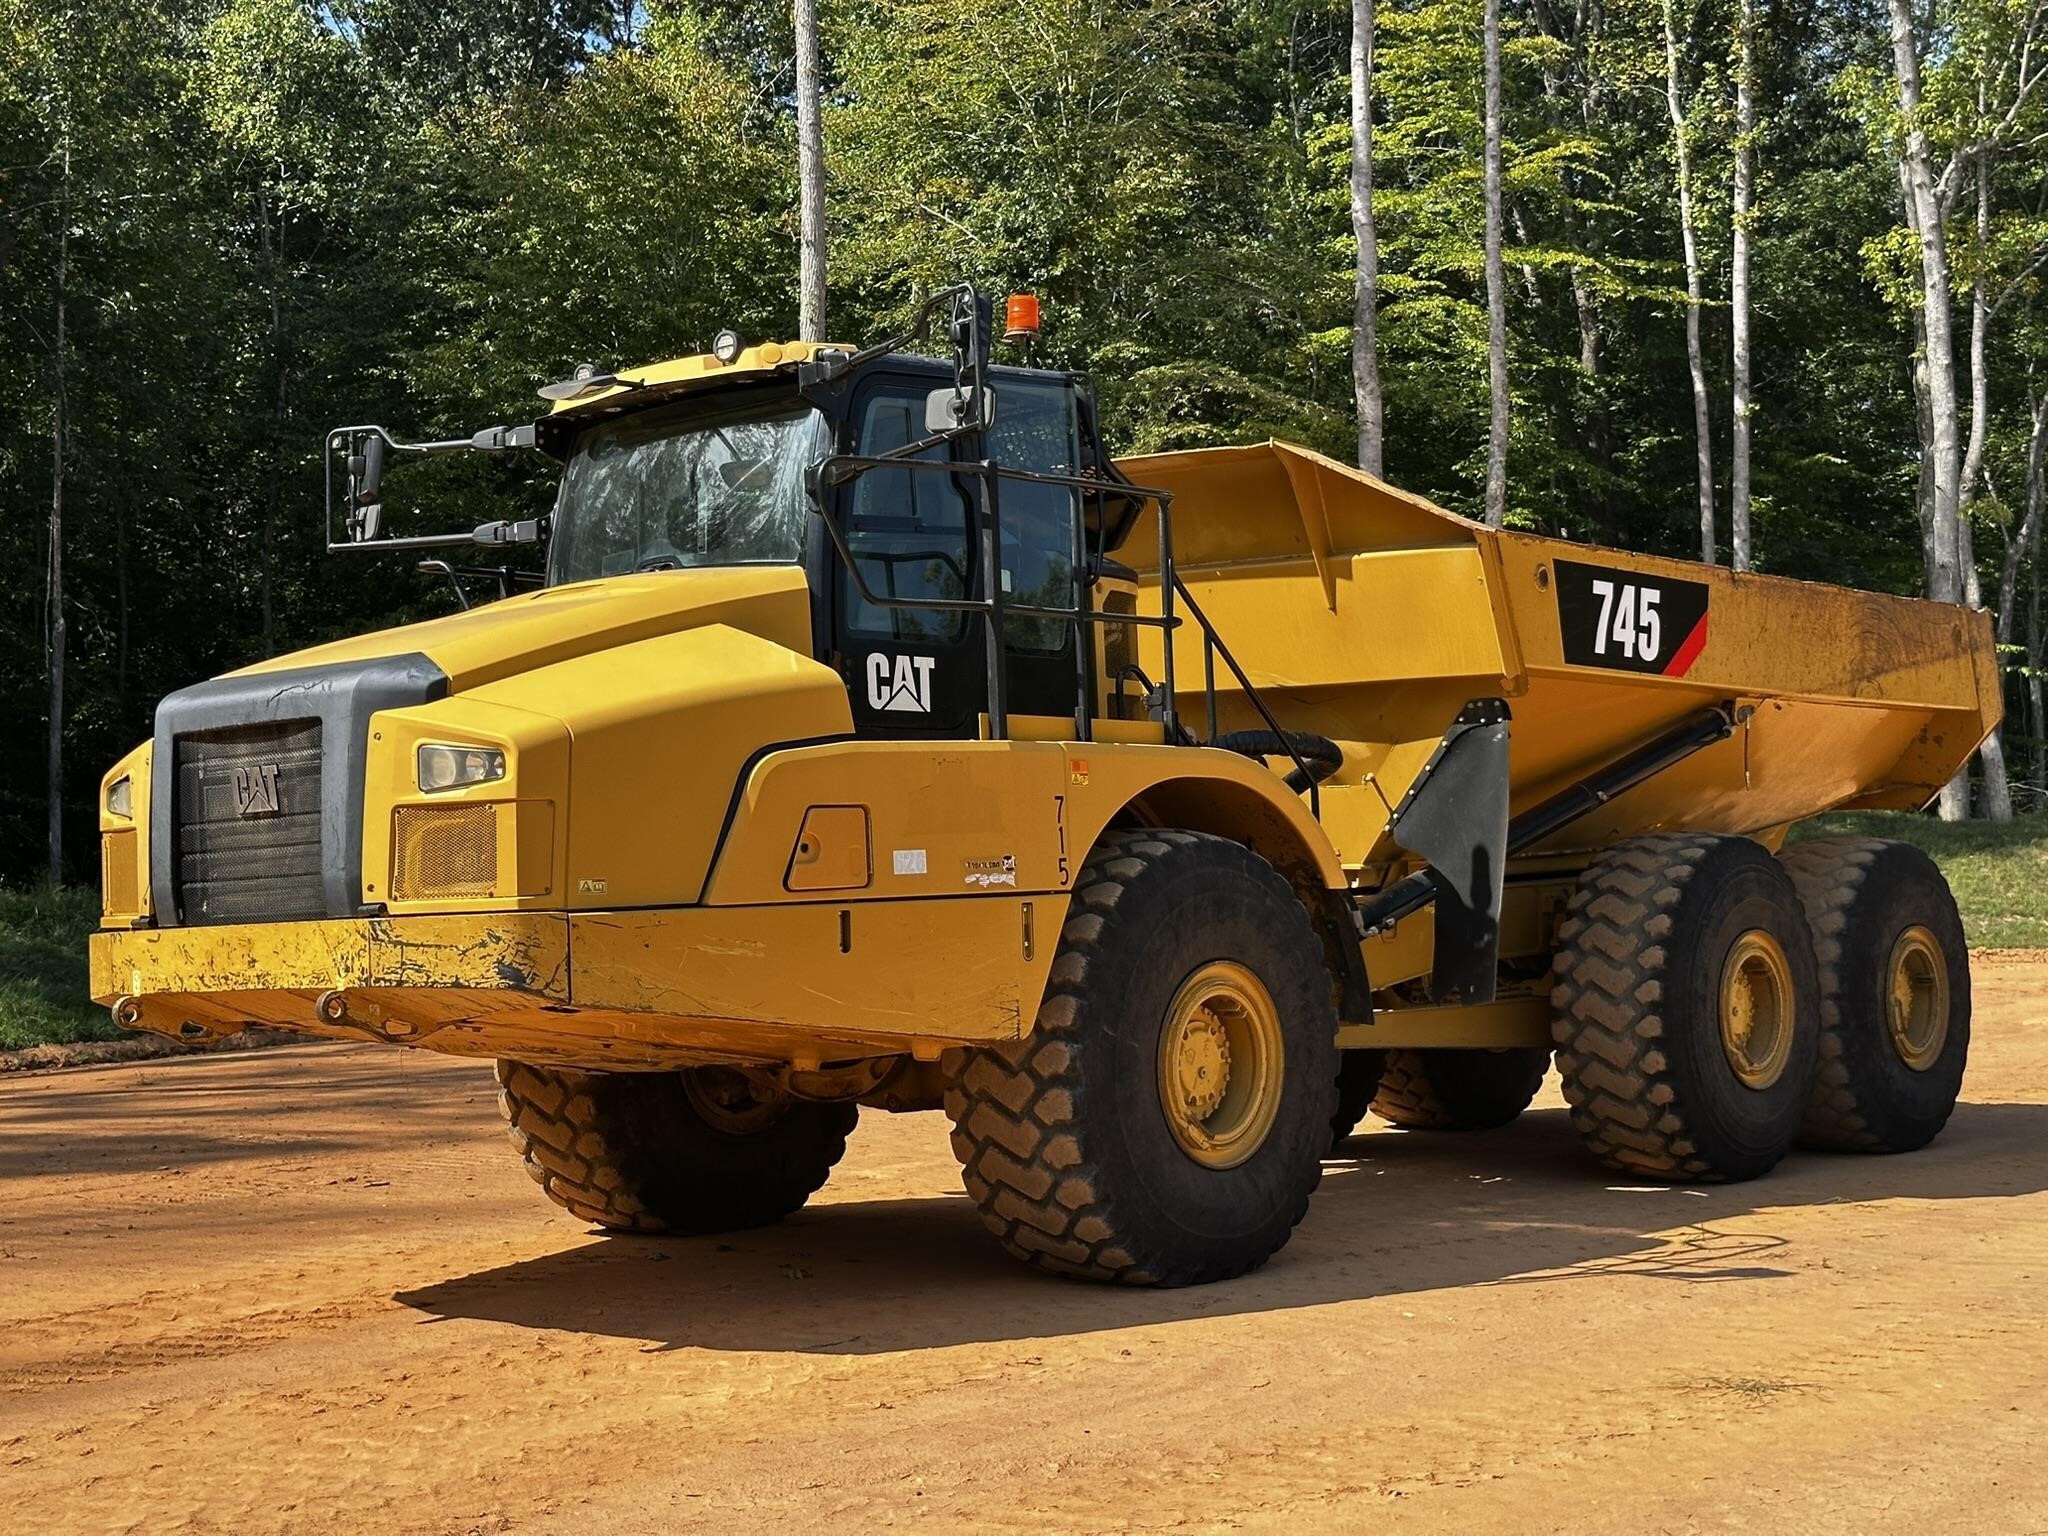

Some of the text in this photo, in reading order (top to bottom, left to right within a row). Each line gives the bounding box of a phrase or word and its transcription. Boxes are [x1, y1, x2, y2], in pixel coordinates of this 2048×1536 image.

[1592, 579, 1661, 662] 745
[866, 652, 935, 713] CAT
[232, 764, 279, 816] CAT
